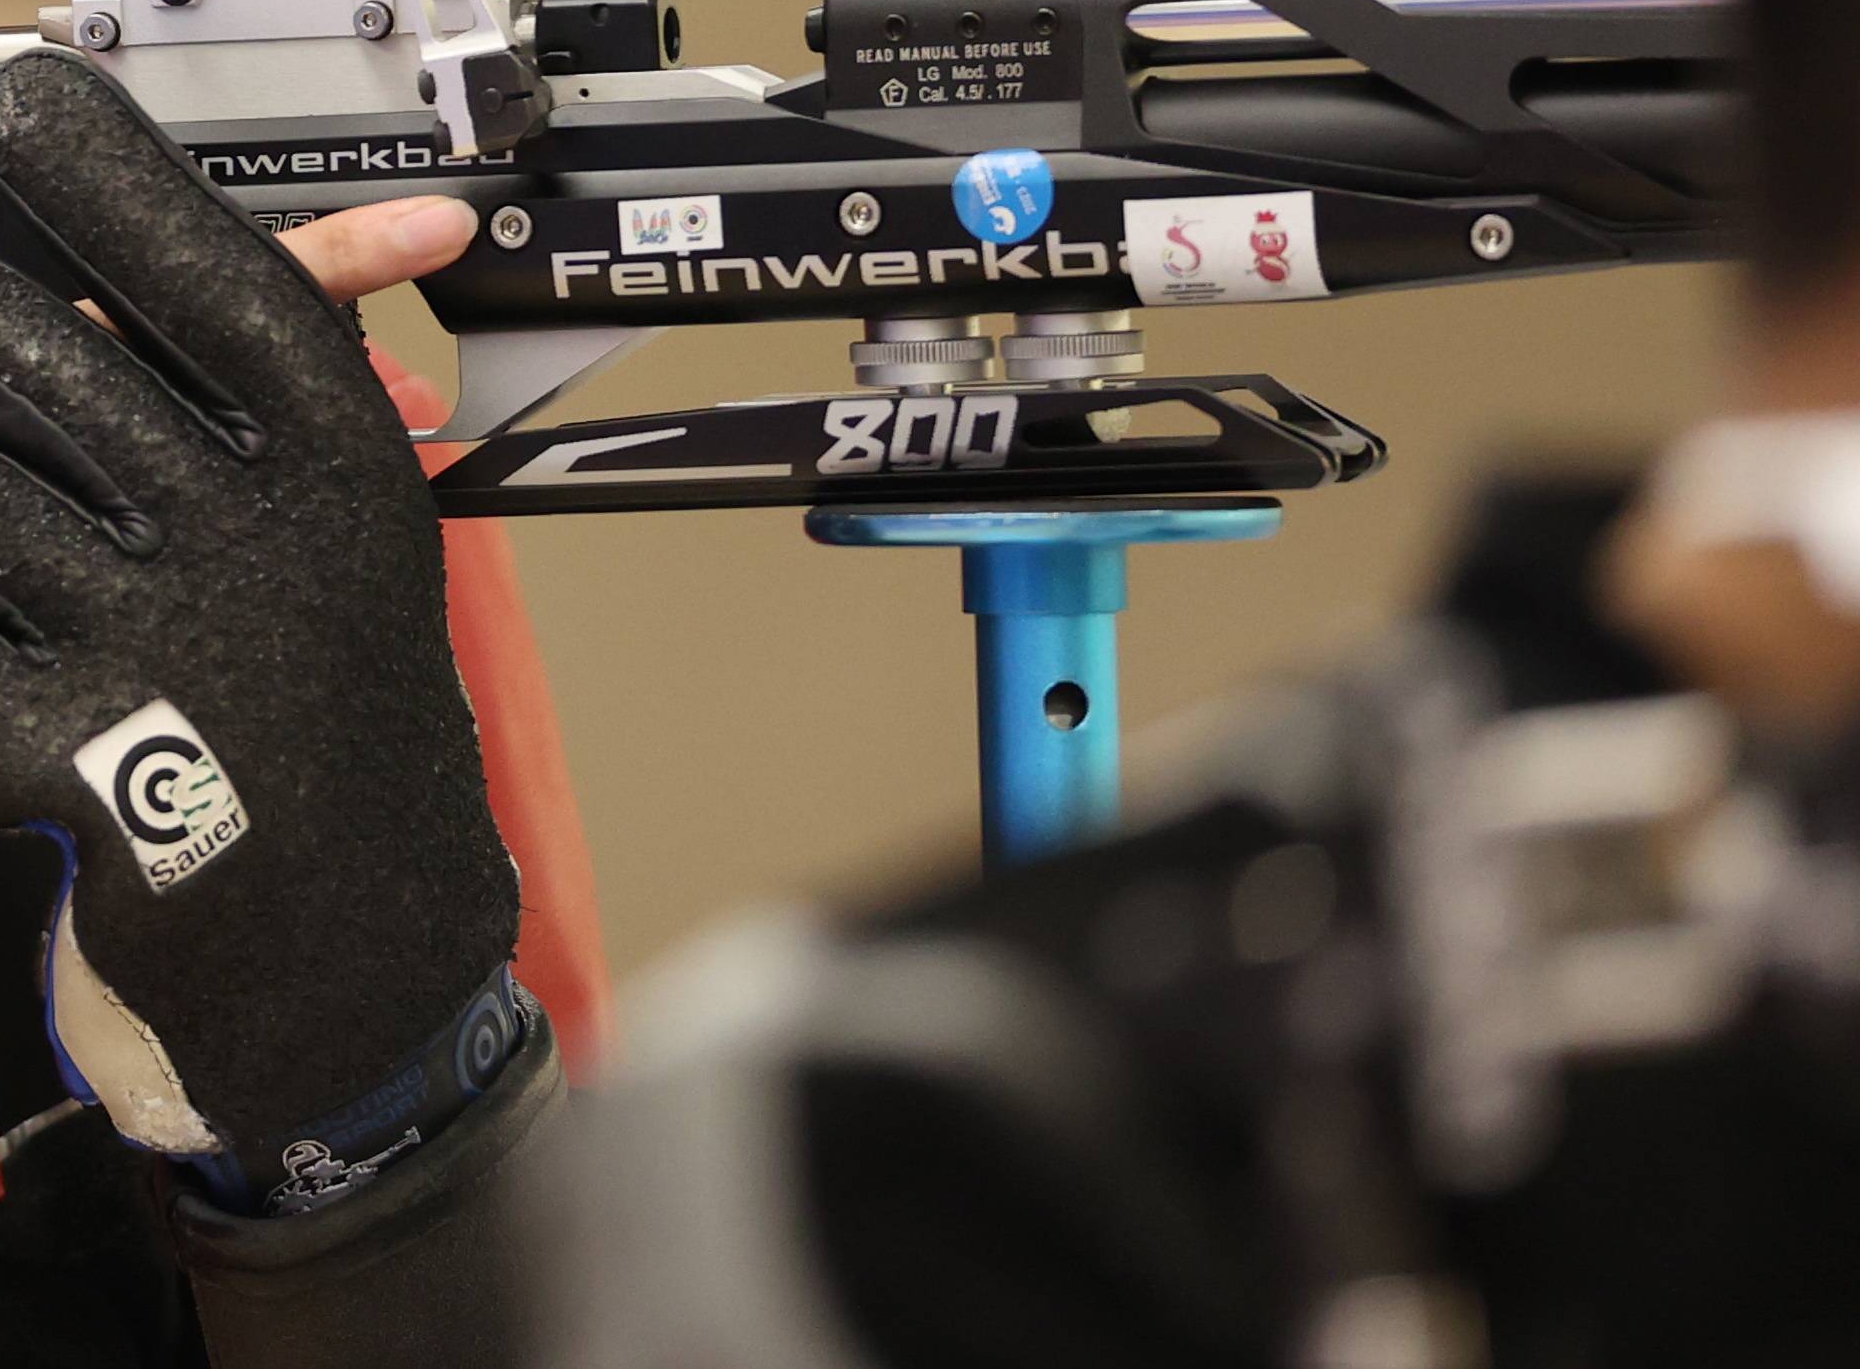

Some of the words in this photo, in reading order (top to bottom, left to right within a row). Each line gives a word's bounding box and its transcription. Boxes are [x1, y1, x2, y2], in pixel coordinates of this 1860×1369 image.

[856, 48, 895, 63] READ
[899, 45, 959, 61] MANUAL
[964, 42, 1020, 59] BEFORE
[1022, 40, 1052, 56] USE
[917, 66, 941, 82] LG
[951, 64, 988, 80] Mod.
[995, 62, 1024, 79] 800
[551, 231, 1131, 298] Feinwerkb
[816, 394, 1019, 475] 800
[150, 808, 242, 887] Sauer
